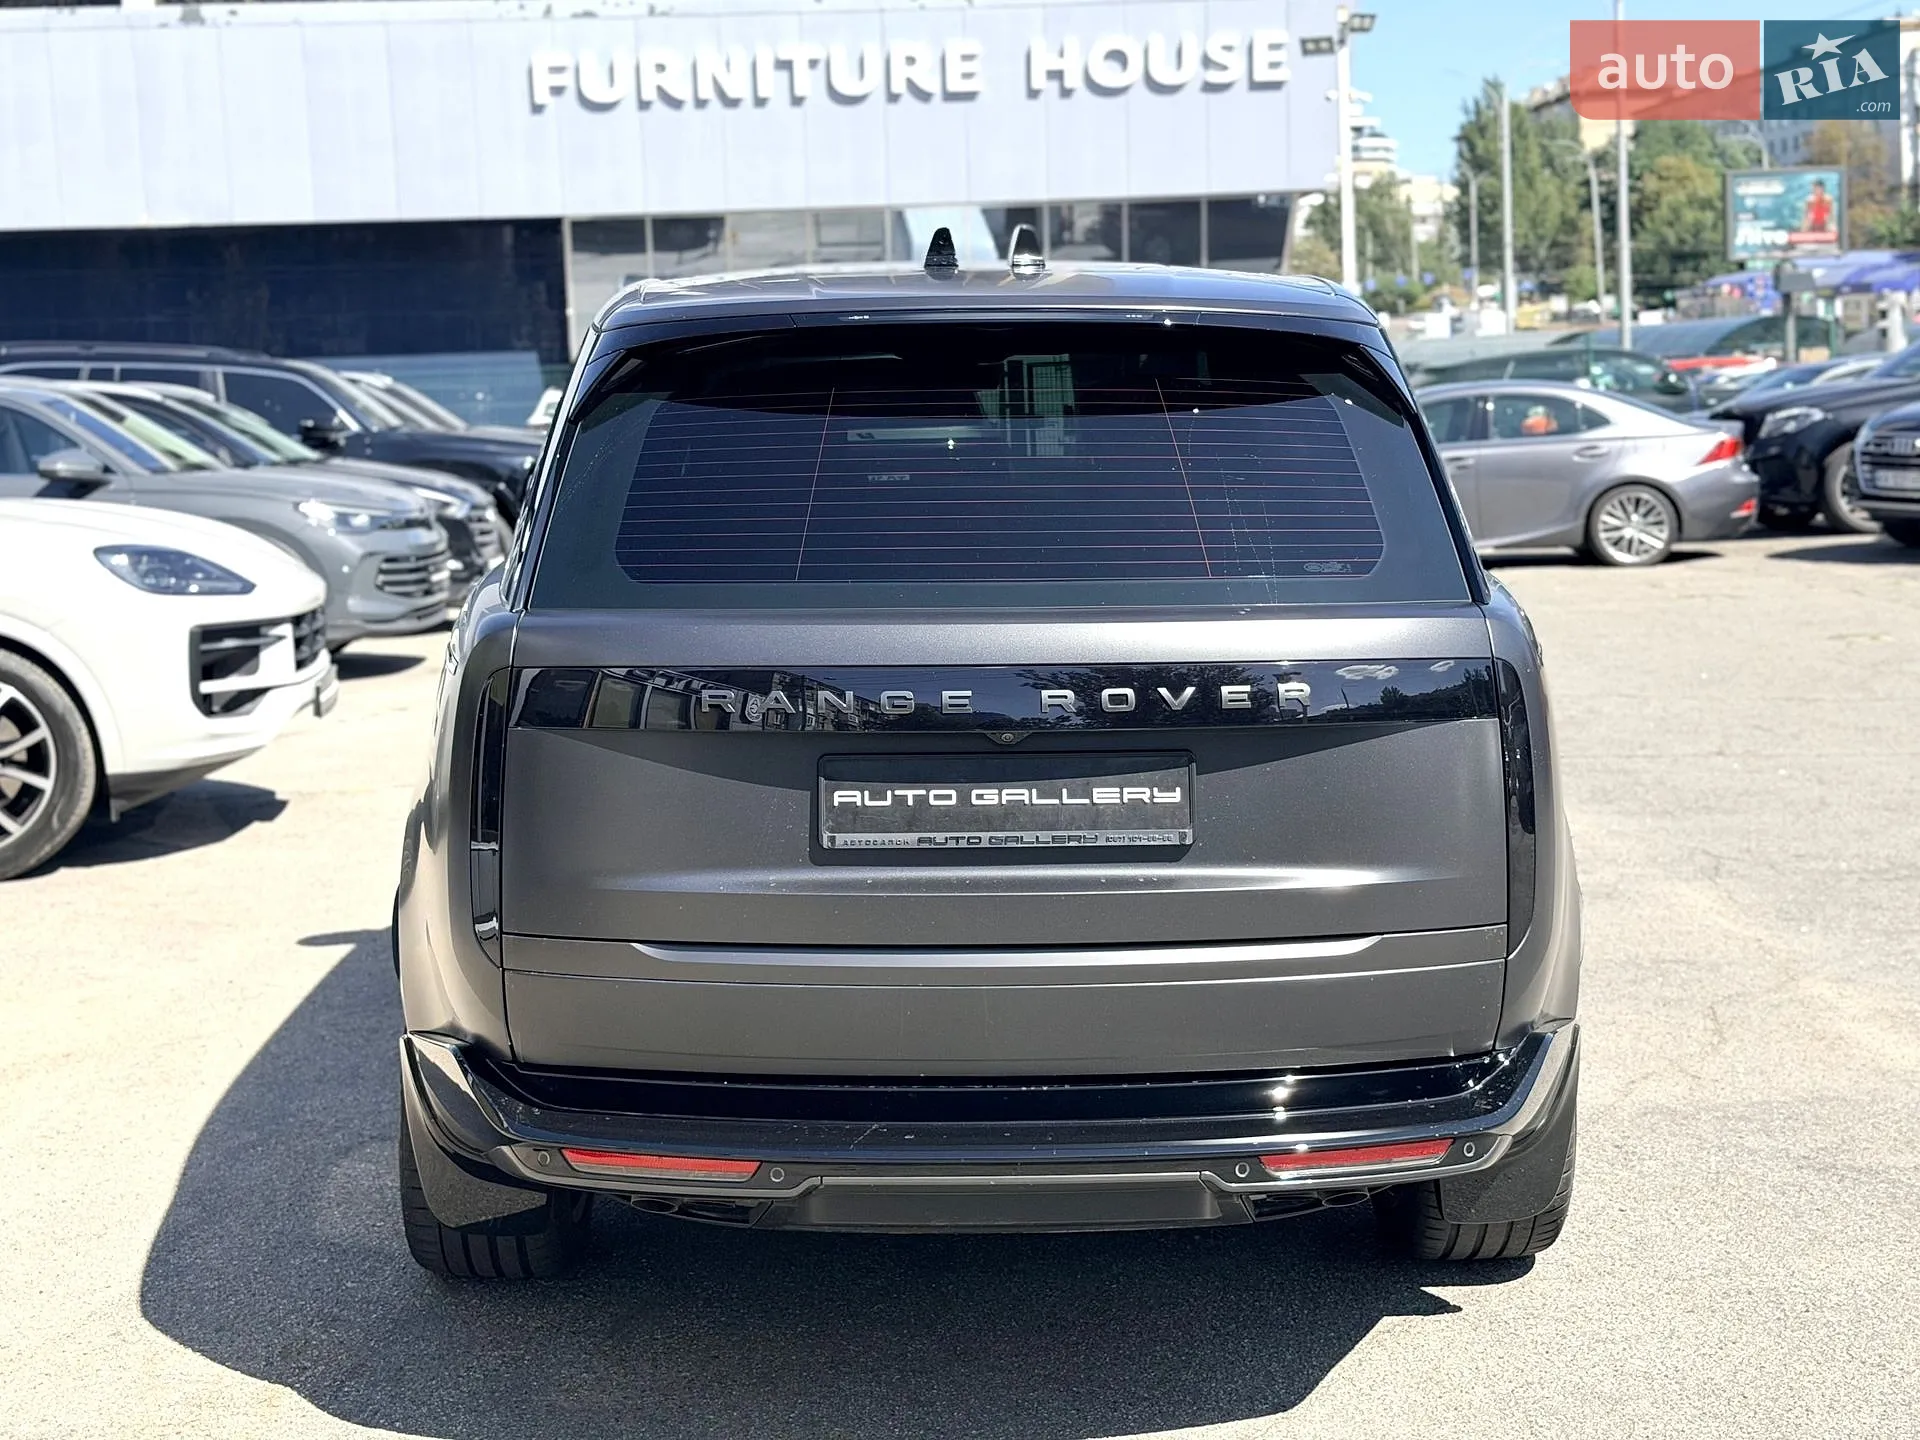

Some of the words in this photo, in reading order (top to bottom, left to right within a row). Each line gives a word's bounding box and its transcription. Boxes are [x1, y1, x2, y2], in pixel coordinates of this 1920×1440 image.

[528, 36, 984, 114] FURNITURE
[1026, 29, 1292, 100] HOUSE
[701, 689, 973, 715] RANGE
[1040, 682, 1311, 713] ROVER
[833, 789, 957, 807] AUTO
[970, 786, 1182, 805] GALLERY
[916, 836, 982, 847] AUTO
[988, 834, 1099, 846] GALLERY
